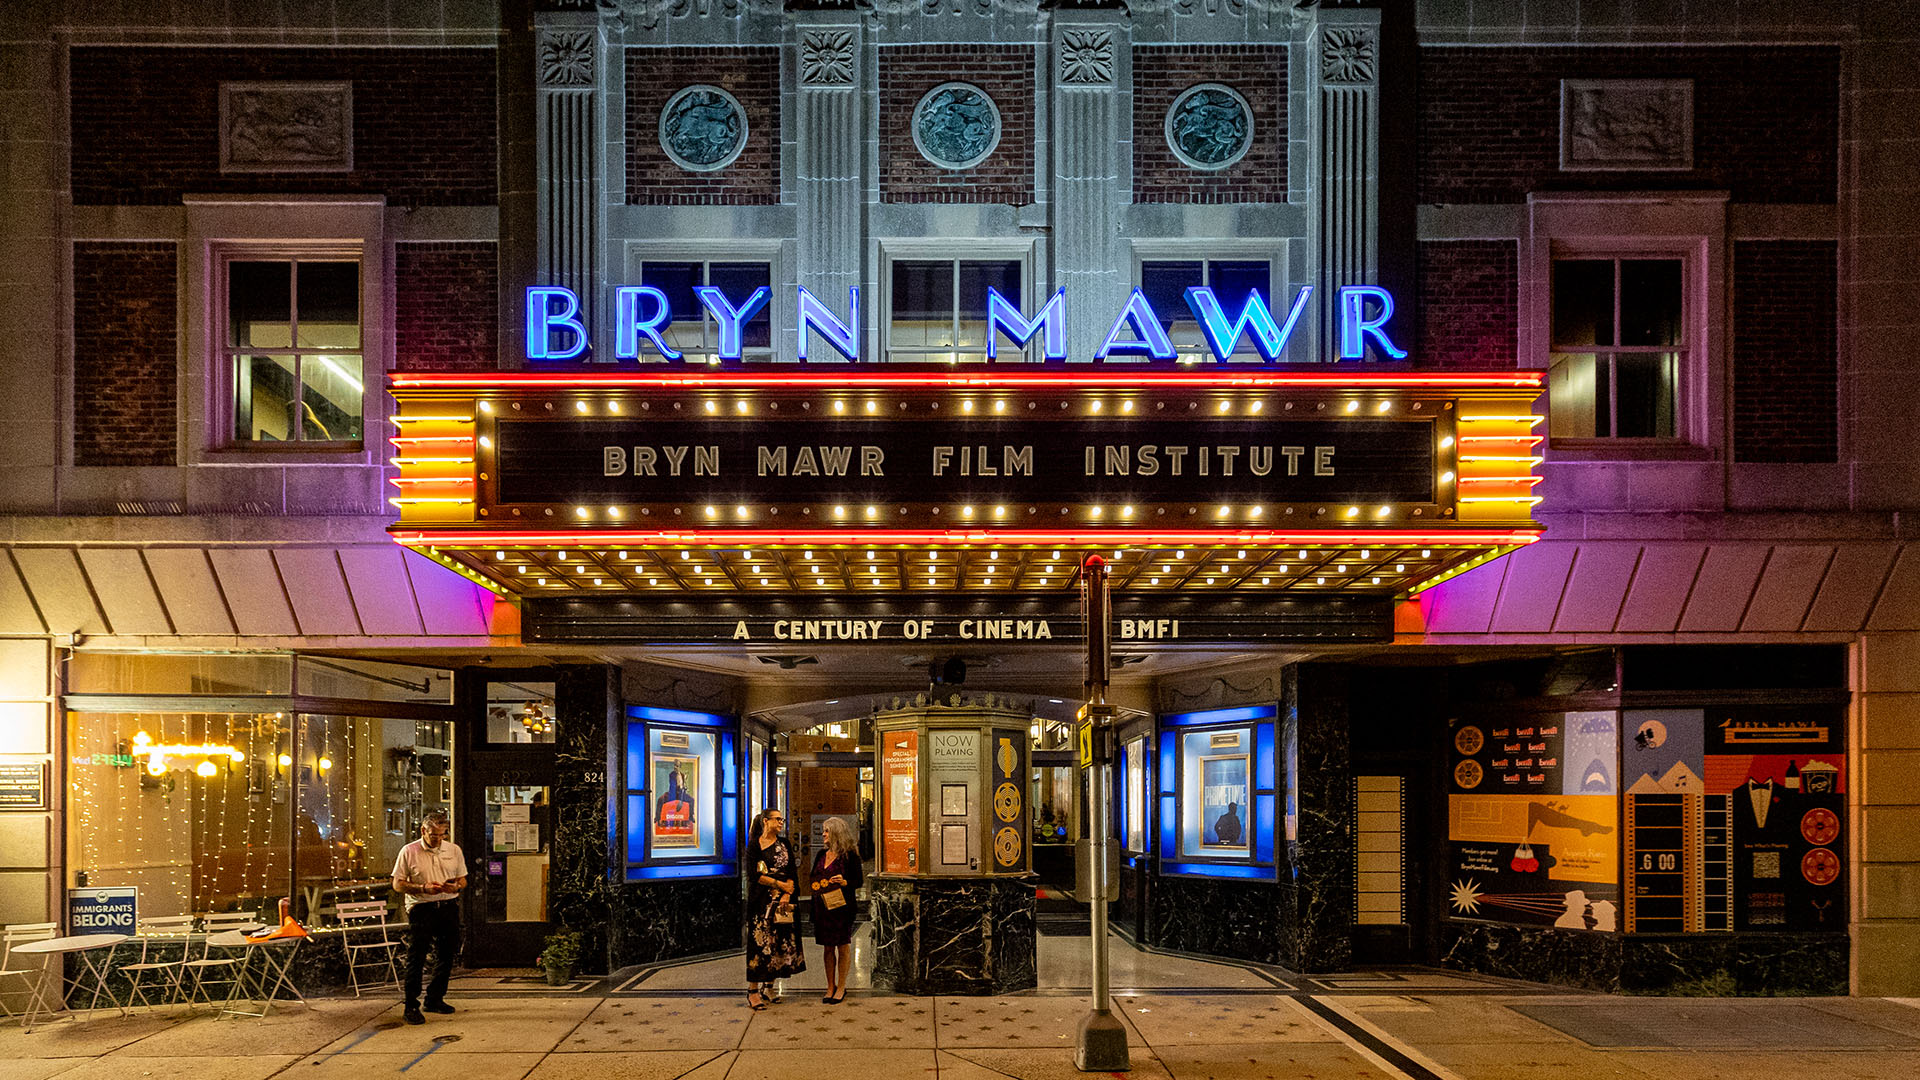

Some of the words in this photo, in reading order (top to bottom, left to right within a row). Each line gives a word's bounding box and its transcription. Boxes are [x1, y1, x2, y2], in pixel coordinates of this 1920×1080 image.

[526, 286, 860, 362] BRYN
[986, 285, 1408, 362] MAWR
[603, 446, 720, 477] BRYN
[757, 446, 885, 477] MAWR
[933, 446, 1034, 477] FILM
[1085, 445, 1336, 477] INSTITUTE
[733, 620, 750, 640] A
[773, 620, 883, 640] CENTURY
[903, 620, 934, 640] OF
[959, 620, 1052, 640] CINEMA
[1120, 619, 1180, 639] BMFI
[935, 735, 974, 747] NOW
[935, 748, 974, 756] PLAYING
[584, 772, 604, 783] 824
[1643, 853, 1652, 871] 6
[1658, 853, 1676, 871] 00
[72, 904, 133, 914] IMMIGRANTS
[72, 913, 133, 927] BELONG
